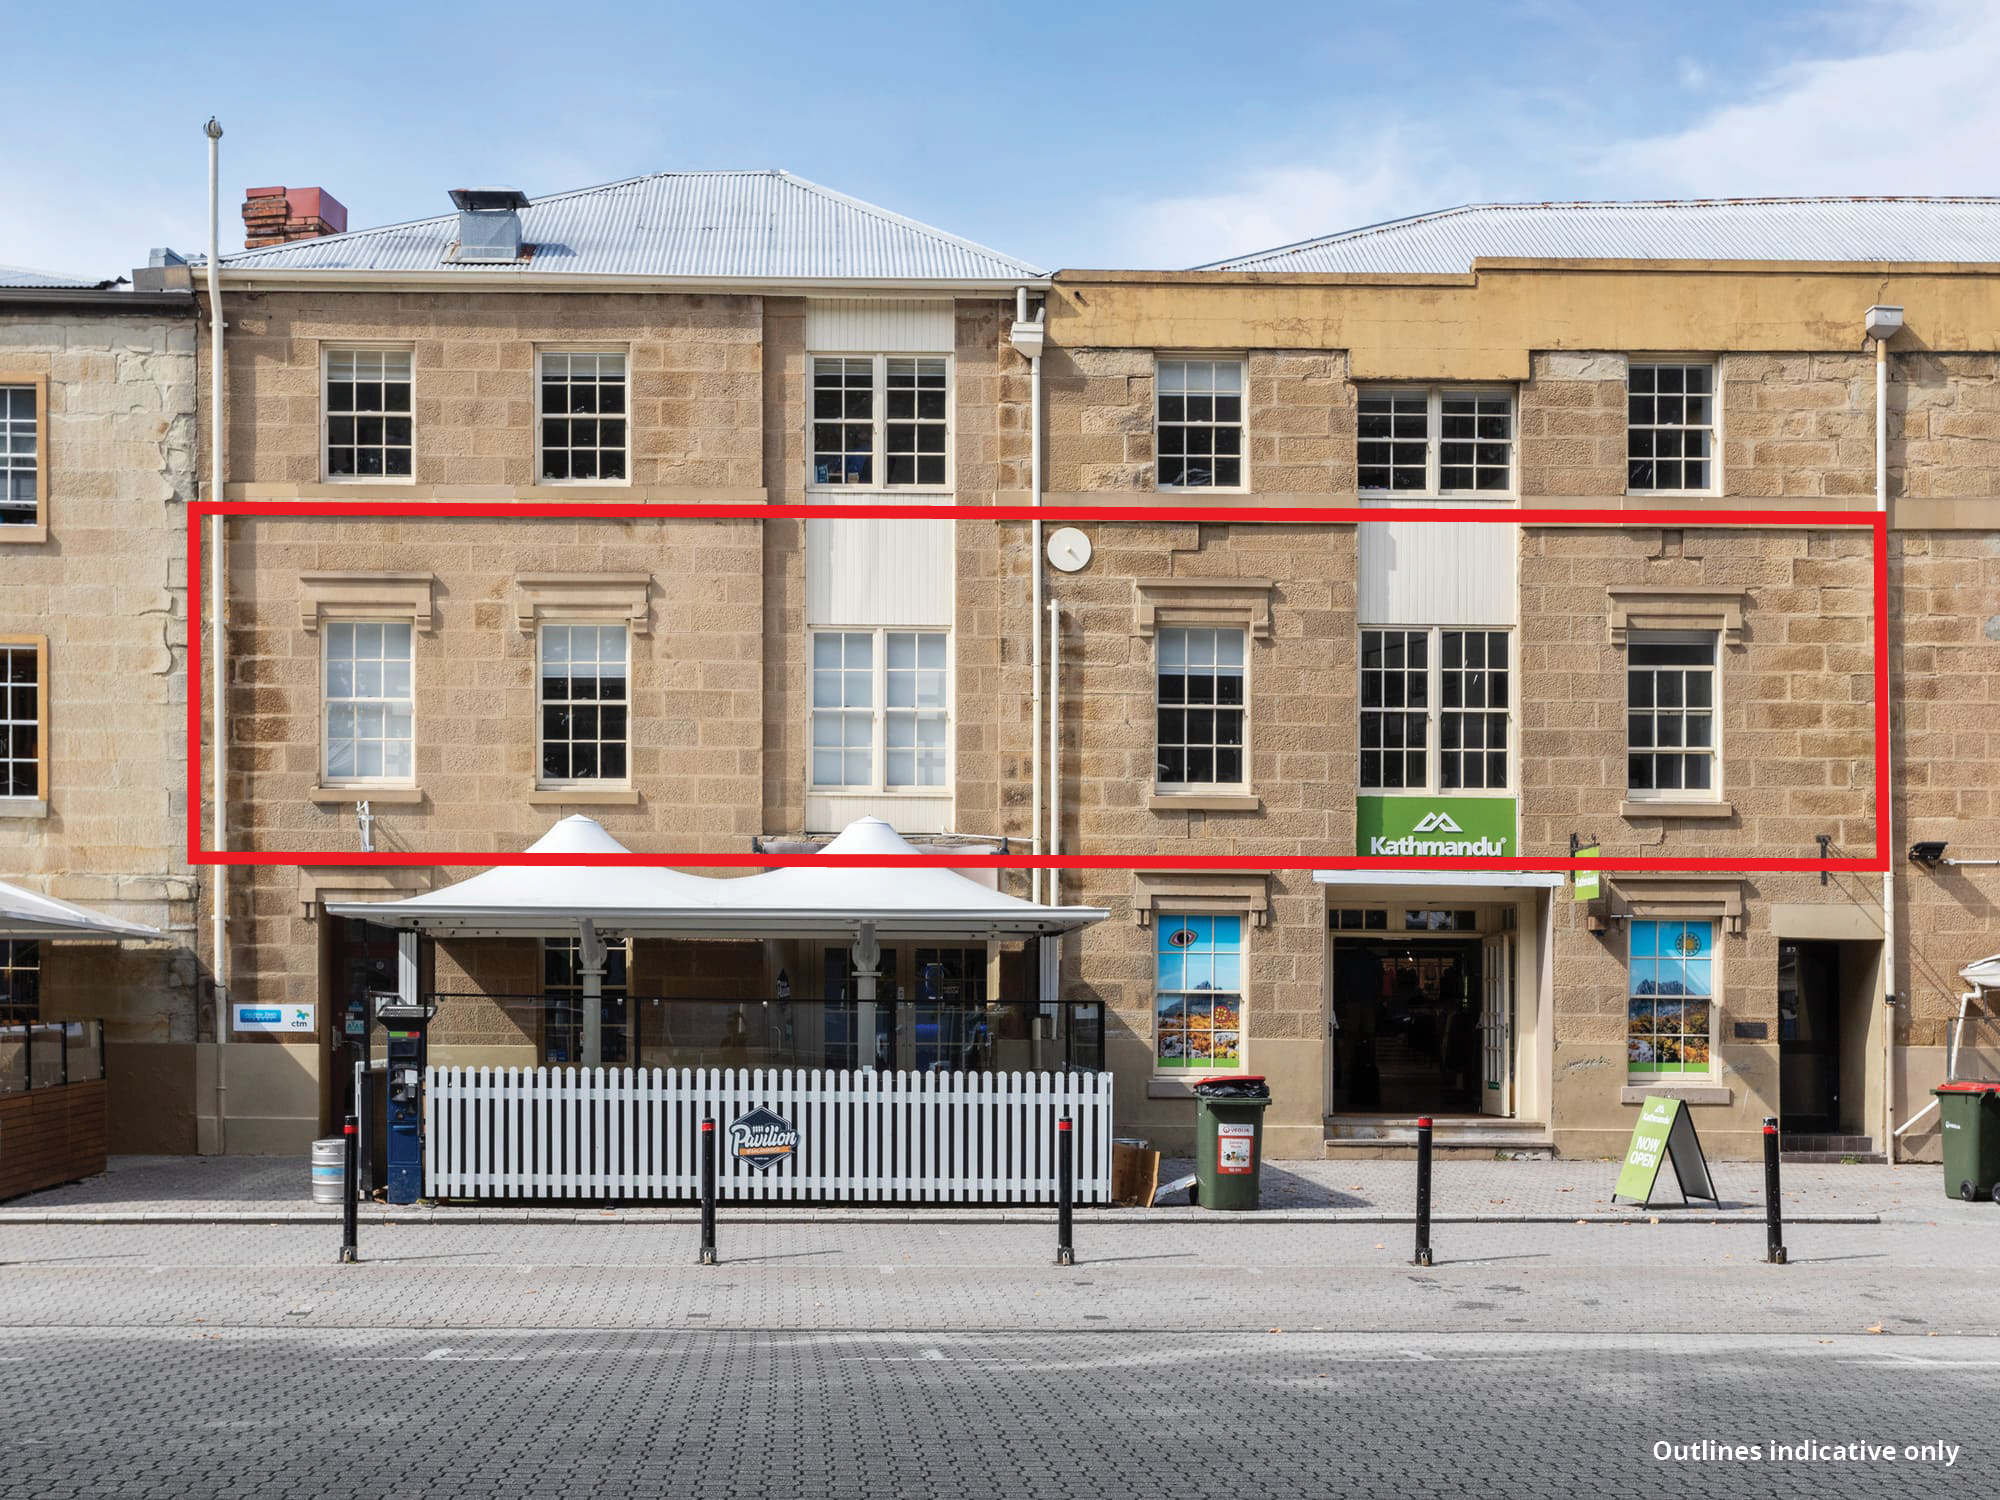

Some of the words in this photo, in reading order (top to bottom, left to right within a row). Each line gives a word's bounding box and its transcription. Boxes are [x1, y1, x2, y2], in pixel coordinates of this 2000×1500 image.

[291, 1020, 308, 1028] ctm
[730, 1123, 798, 1156] Pavilion
[1636, 1135, 1661, 1153] NOW
[1629, 1151, 1657, 1169] OPEN
